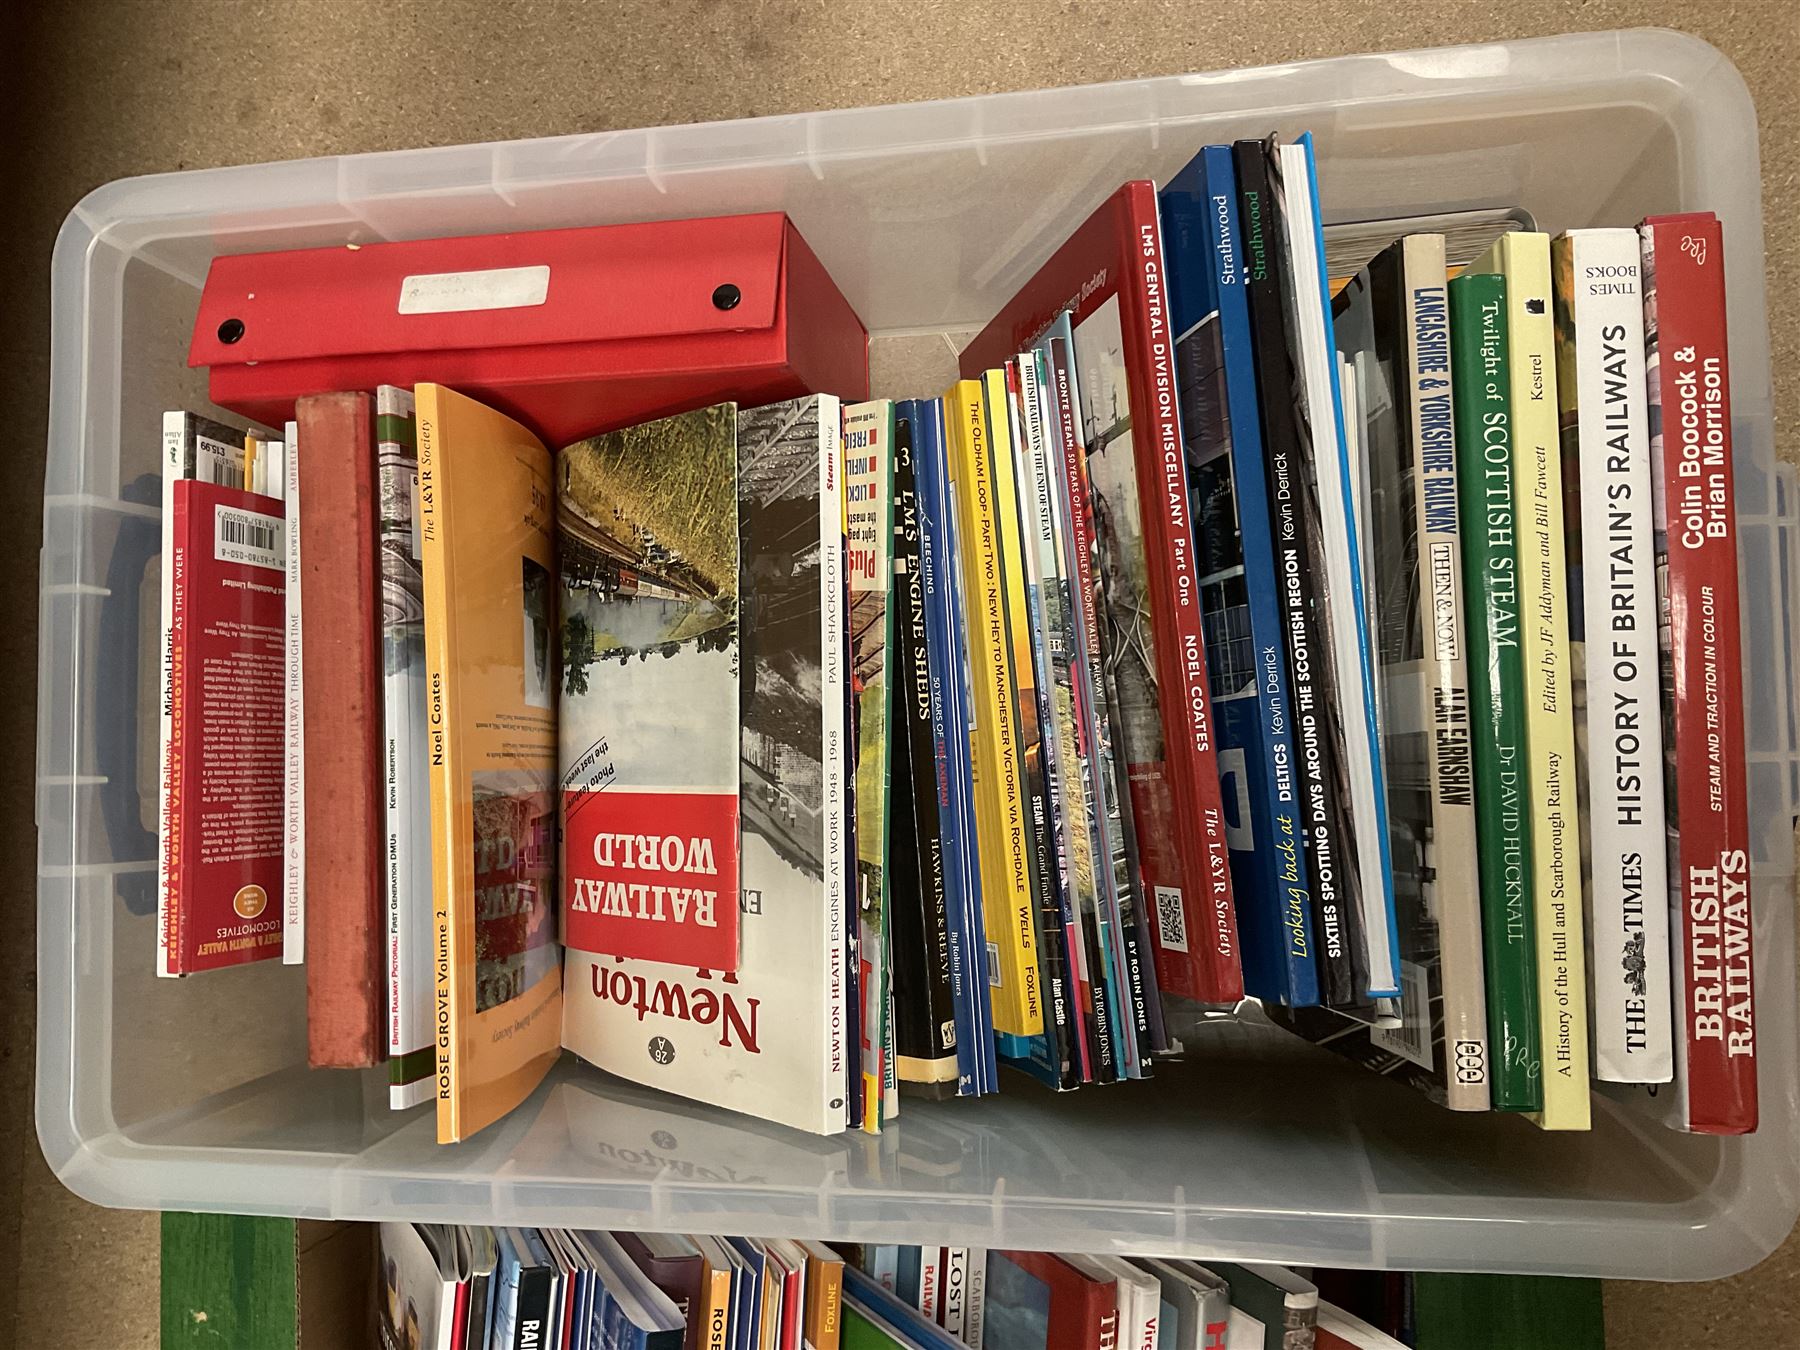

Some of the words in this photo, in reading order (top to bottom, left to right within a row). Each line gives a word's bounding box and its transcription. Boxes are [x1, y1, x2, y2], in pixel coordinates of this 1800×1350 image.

[1140, 225, 1155, 257] LMS
[1216, 195, 1236, 285] Strathwood
[1248, 191, 1267, 281] Strathwood
[1586, 266, 1637, 278] BOOKS
[1590, 283, 1635, 295] TIMES
[1144, 261, 1164, 339] CENTRAL
[1414, 287, 1449, 374] LANCASHIRE
[1480, 301, 1499, 376] Twilight
[1674, 346, 1696, 362] &
[1025, 365, 1035, 402] BRITISH
[1153, 343, 1171, 418] DIVISION
[1419, 378, 1448, 391] &
[1486, 382, 1504, 401] of
[1528, 353, 1544, 400] Kestrel
[1602, 324, 1631, 473] RAILWAYS
[1028, 404, 1040, 451] RAILWAYS
[1674, 371, 1701, 478] Boocock
[1702, 357, 1725, 466] Morrison
[201, 442, 225, 456] £15.99
[421, 419, 433, 466] Society
[1419, 394, 1454, 474] YORKSHIRE
[826, 452, 834, 491] Steam
[901, 447, 910, 467] 3
[1034, 452, 1042, 471] THE
[1161, 423, 1184, 527] MISCELLANY
[1273, 452, 1290, 500] Derrick
[1533, 446, 1548, 499] Fawcett
[422, 471, 433, 514] L&YR
[1036, 472, 1045, 491] END
[1039, 491, 1047, 506] OF
[1482, 412, 1514, 547] SCOTTISH
[1040, 507, 1051, 541] STEAM
[1280, 504, 1295, 541] Kevin
[1423, 478, 1457, 535] RAILWAY
[1535, 503, 1549, 528] Bill
[1678, 484, 1705, 550] Colin
[1705, 472, 1728, 538] Brian
[424, 519, 435, 542] The
[1538, 531, 1550, 556] and
[924, 535, 934, 594] BEECHING
[1171, 537, 1189, 571] Part
[1433, 546, 1451, 596] THEN
[1607, 484, 1635, 631] BRITAIN’S
[827, 545, 836, 642] SHACKCLOTH
[907, 554, 924, 639] ENGINE
[1178, 575, 1193, 607] One
[1282, 549, 1303, 607] REGION
[1541, 561, 1555, 624] Addyman
[290, 613, 299, 636] TIME
[1436, 599, 1451, 612] &
[1488, 557, 1517, 648] STEAM
[1701, 585, 1715, 643] COLOUR
[1183, 634, 1203, 681] NOEL
[1290, 611, 1311, 682] SCOTTISH
[1435, 613, 1456, 658] NOW
[1540, 628, 1554, 646] JF
[1704, 645, 1715, 660] IN
[290, 638, 299, 692] THROUGH
[828, 647, 836, 684] PAUL
[1262, 645, 1279, 693] Derrick
[1542, 649, 1558, 667] by
[1612, 640, 1639, 683] OF
[430, 673, 442, 725] Coates
[914, 646, 931, 720] SHEDS
[1298, 685, 1315, 711] THE
[1433, 687, 1467, 723] ALAN
[1541, 671, 1558, 715] Edited
[1704, 662, 1719, 731] TRACTION
[290, 698, 298, 748] RAILWAY
[1190, 685, 1209, 752] COATES
[1268, 697, 1285, 735] Kevin
[432, 730, 443, 766] Noel
[827, 730, 837, 761] 1968
[1302, 715, 1322, 780] AROUND
[1434, 727, 1471, 806] EARNSHAW
[1499, 746, 1518, 766] Dr
[1613, 691, 1642, 826] HISTORY
[1706, 734, 1720, 763] AND
[290, 753, 299, 795] VALLEY
[828, 772, 838, 804] 1948
[1273, 743, 1293, 802] DELTICS
[1544, 750, 1563, 808] Railway
[1707, 765, 1723, 812] STEAM
[290, 800, 298, 843] WORTH
[1032, 795, 1045, 825] STEAM
[1202, 807, 1221, 838] The
[1280, 813, 1295, 834] at
[1311, 783, 1327, 821] DAYS
[1500, 771, 1521, 832] DAVID
[290, 848, 298, 859] &
[593, 832, 717, 875] WORLD
[829, 811, 838, 854] WORK
[1035, 826, 1046, 844] The
[829, 858, 838, 876] AT
[931, 837, 943, 914] HAWKINS
[1037, 845, 1050, 877] Grand
[1207, 841, 1227, 895] L&YR
[1280, 838, 1299, 882] back
[1315, 825, 1336, 900] SPOTTING
[1545, 811, 1568, 899] Scarborough
[290, 864, 299, 925] KEIGHLEY
[572, 878, 717, 928] RAILWAY
[829, 880, 839, 942] ENGINES
[1039, 879, 1052, 905] Finale
[1502, 836, 1524, 945] HUCKNALL
[1620, 852, 1643, 932] TIMES
[437, 910, 446, 918] 2
[936, 917, 944, 928] &
[1018, 906, 1032, 949] WELLS
[1214, 898, 1235, 958] Society
[1286, 887, 1310, 958] Looking
[1323, 904, 1342, 958] SIXTIES
[1550, 903, 1566, 927] and
[437, 925, 448, 982] Volume
[938, 931, 950, 984] REEVE
[1128, 941, 1137, 957] BY
[1549, 932, 1569, 962] Hull
[1689, 865, 1724, 1041] BRITISH
[1720, 849, 1754, 1058] RAILWAYS
[830, 947, 840, 999] HEATH
[1024, 966, 1039, 1018] FOXLINE
[1052, 978, 1064, 997] Alan
[1094, 987, 1103, 1003] BY
[1131, 961, 1142, 994] ROBIN
[1550, 967, 1570, 989] the
[438, 989, 449, 1048] GROVE
[591, 964, 760, 1054] Newton
[1054, 998, 1066, 1026] Castle
[1096, 1004, 1107, 1033] ROBIN
[1134, 996, 1147, 1032] JONES
[1552, 990, 1569, 1007] of
[657, 1038, 666, 1048] A
[830, 1006, 841, 1073] NEWTON
[1554, 1010, 1575, 1062] History
[1624, 999, 1647, 1053] THE
[655, 1049, 668, 1063] 26
[1099, 1034, 1111, 1066] JONES
[1557, 1064, 1572, 1077] A
[440, 1055, 449, 1099] ROSE
[949, 1252, 963, 1318] LOST
[712, 1309, 723, 1350] ROSE
[825, 1283, 836, 1333] FOXLINE
